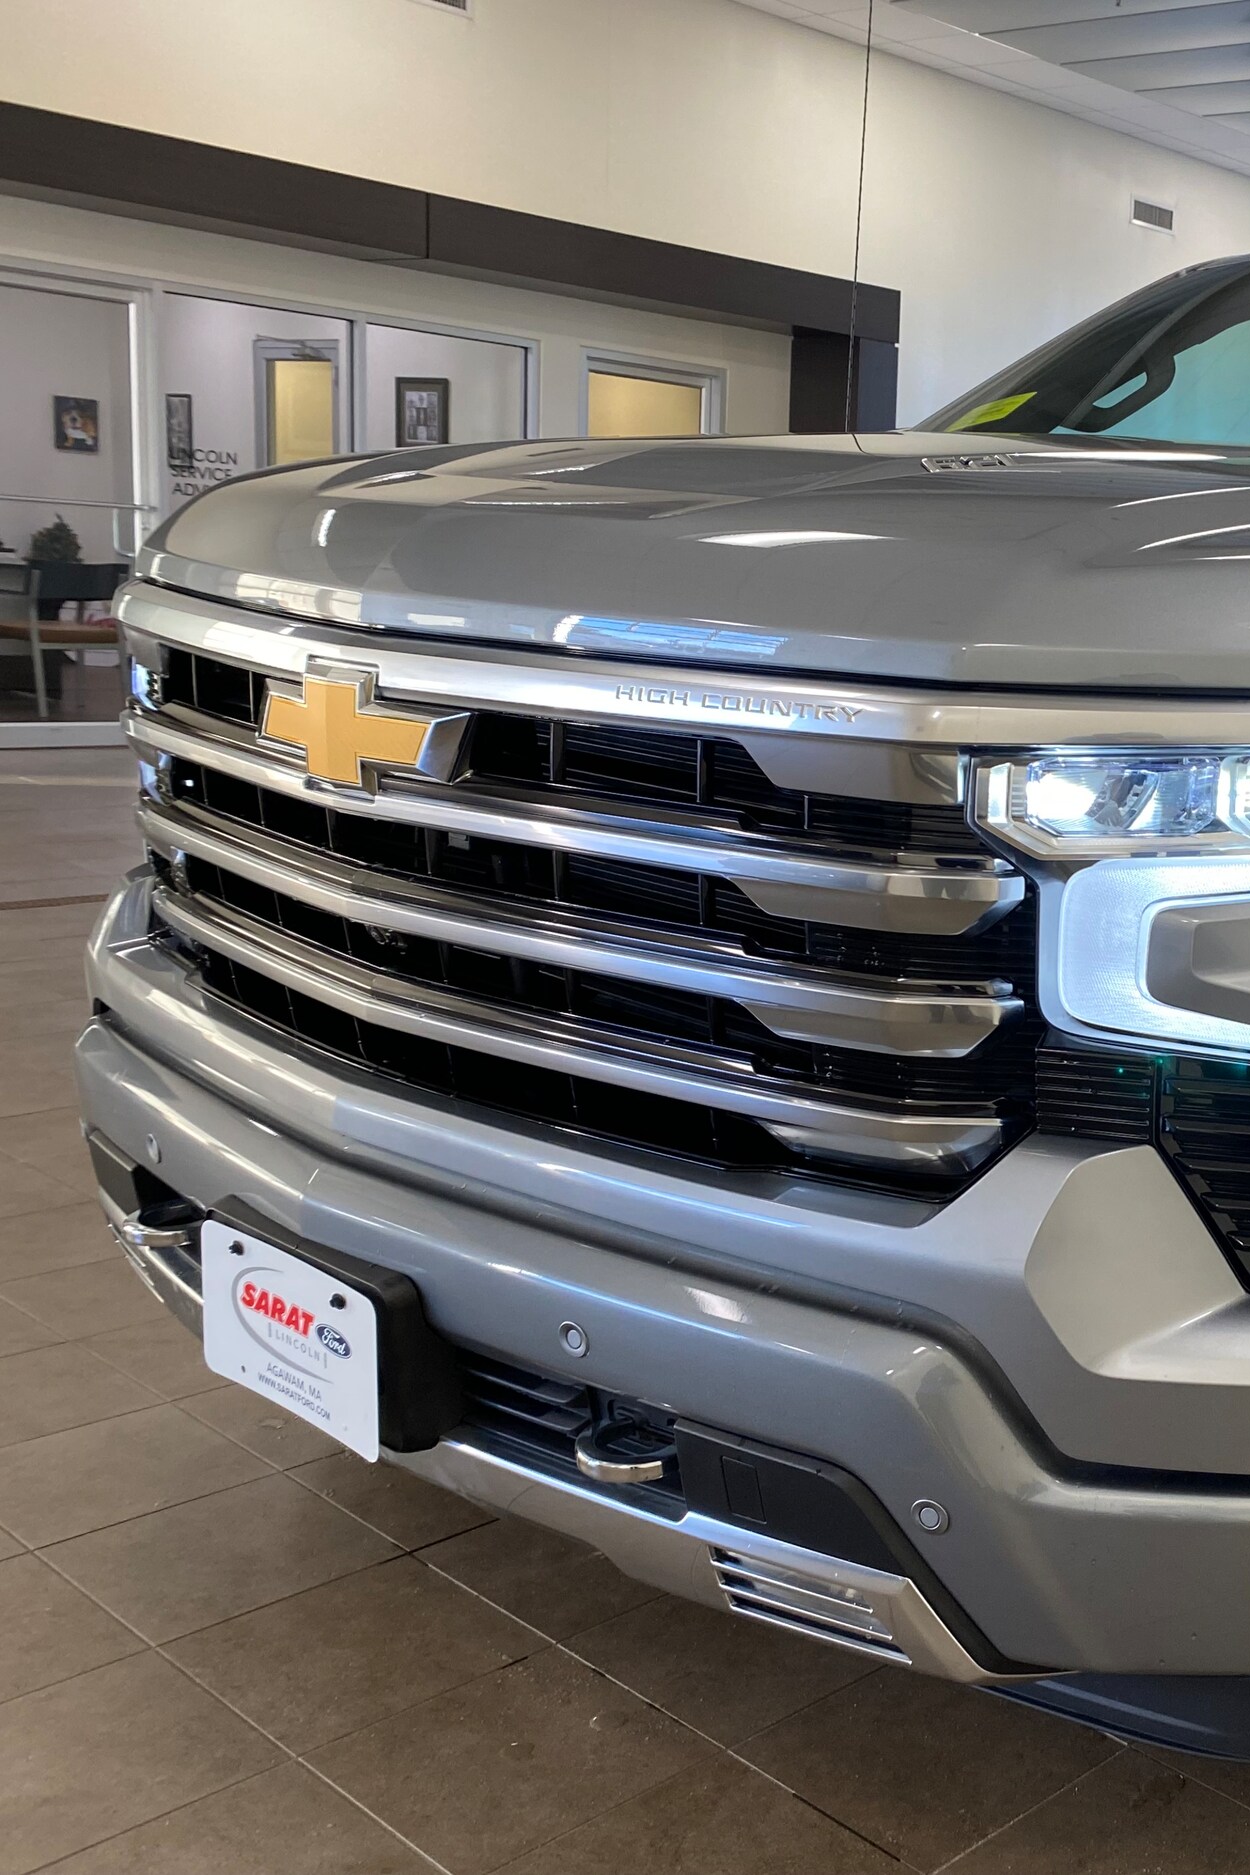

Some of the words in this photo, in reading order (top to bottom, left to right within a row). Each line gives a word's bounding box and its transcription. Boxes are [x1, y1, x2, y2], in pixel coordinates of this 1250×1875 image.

[170, 465, 233, 481] SERVICE
[615, 684, 691, 706] HIGH
[700, 693, 865, 724] COUNTRY
[240, 1281, 316, 1339] SARAT
[274, 1328, 321, 1362] LINCOLN
[320, 1326, 347, 1356] Ford
[266, 1361, 307, 1394] AGAWAM,
[308, 1384, 322, 1403] MA
